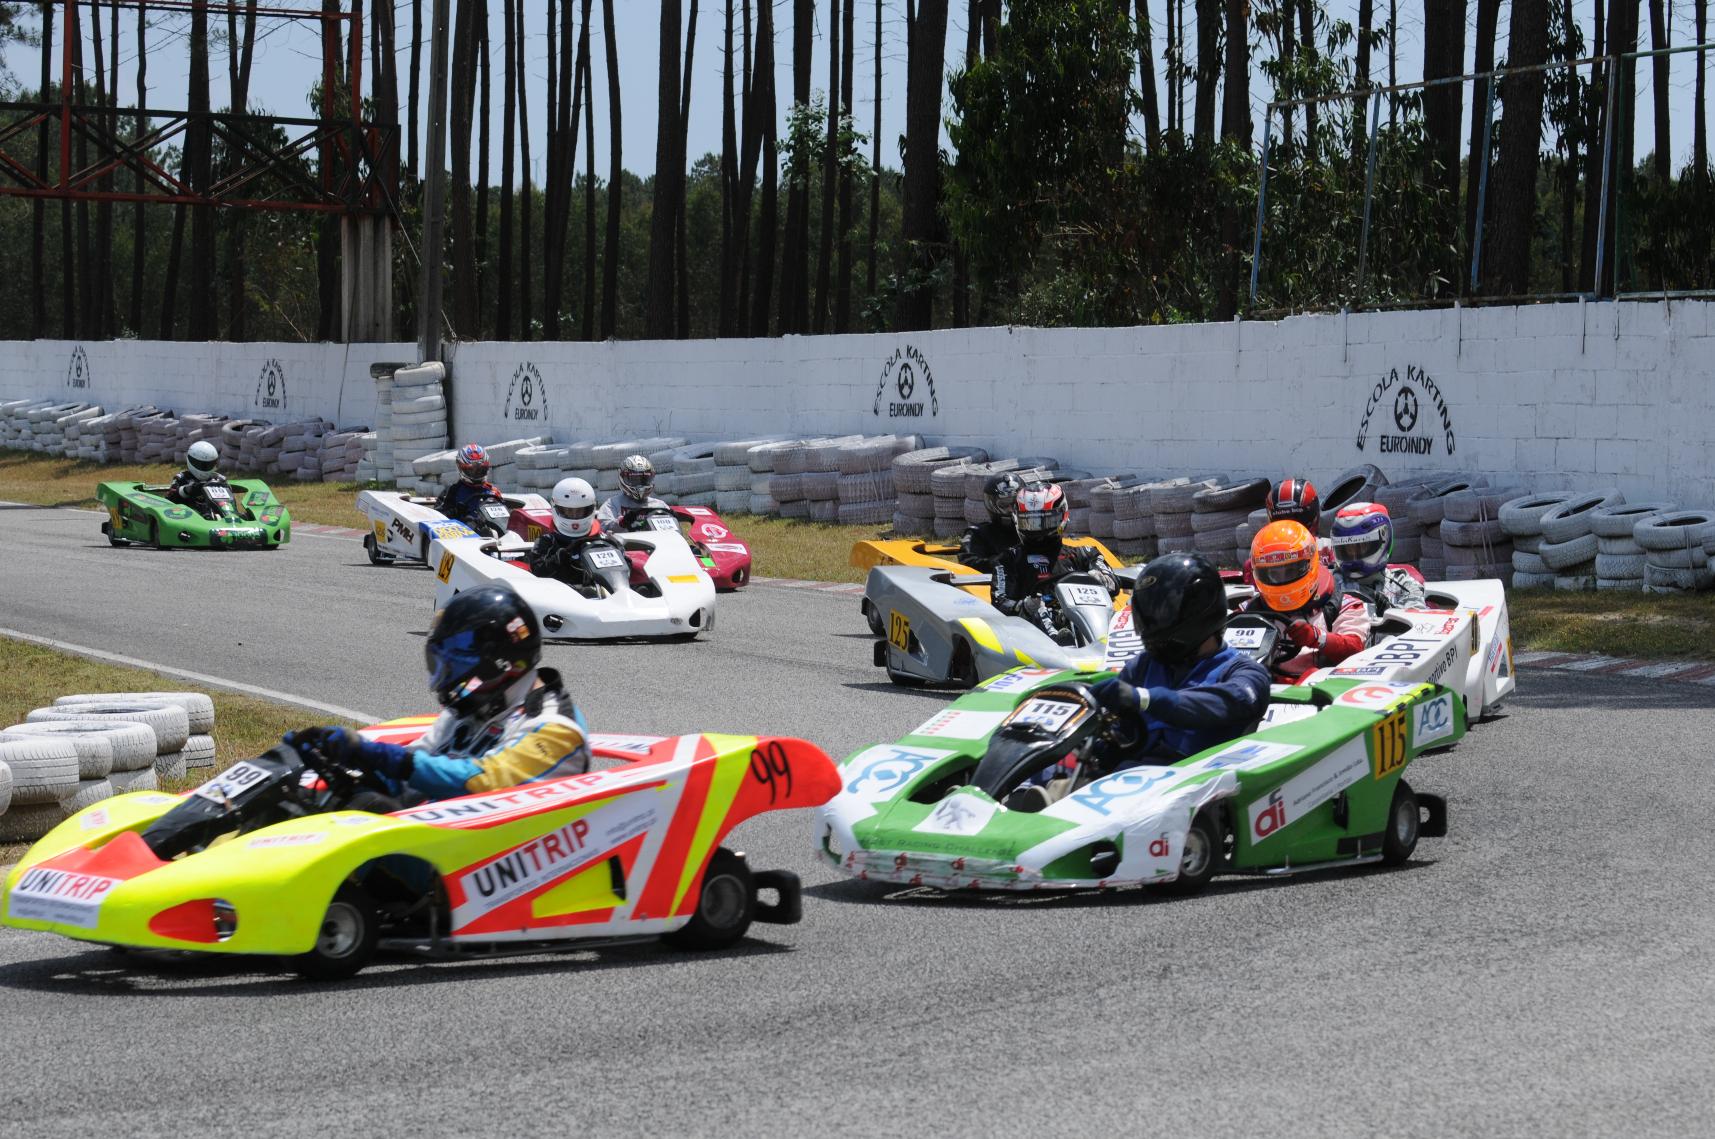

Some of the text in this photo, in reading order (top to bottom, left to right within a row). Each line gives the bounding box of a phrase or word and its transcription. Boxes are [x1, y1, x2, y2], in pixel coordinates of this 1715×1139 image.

[874, 345, 938, 416] ESCOLA KARTING
[889, 402, 925, 417] EUROINDY
[1357, 364, 1455, 455] ESCOLA KARTING
[1380, 434, 1433, 454] EUROINDY
[1076, 586, 1098, 595] 125
[890, 612, 910, 651] 125
[1235, 629, 1256, 637] 90
[1032, 702, 1071, 716] 115
[1378, 714, 1407, 776] 115
[226, 765, 262, 786] 99
[750, 740, 793, 806] 99
[410, 774, 604, 822] UNITRIP
[473, 818, 591, 897] UNITRIP
[20, 868, 113, 900] UNITRIP
